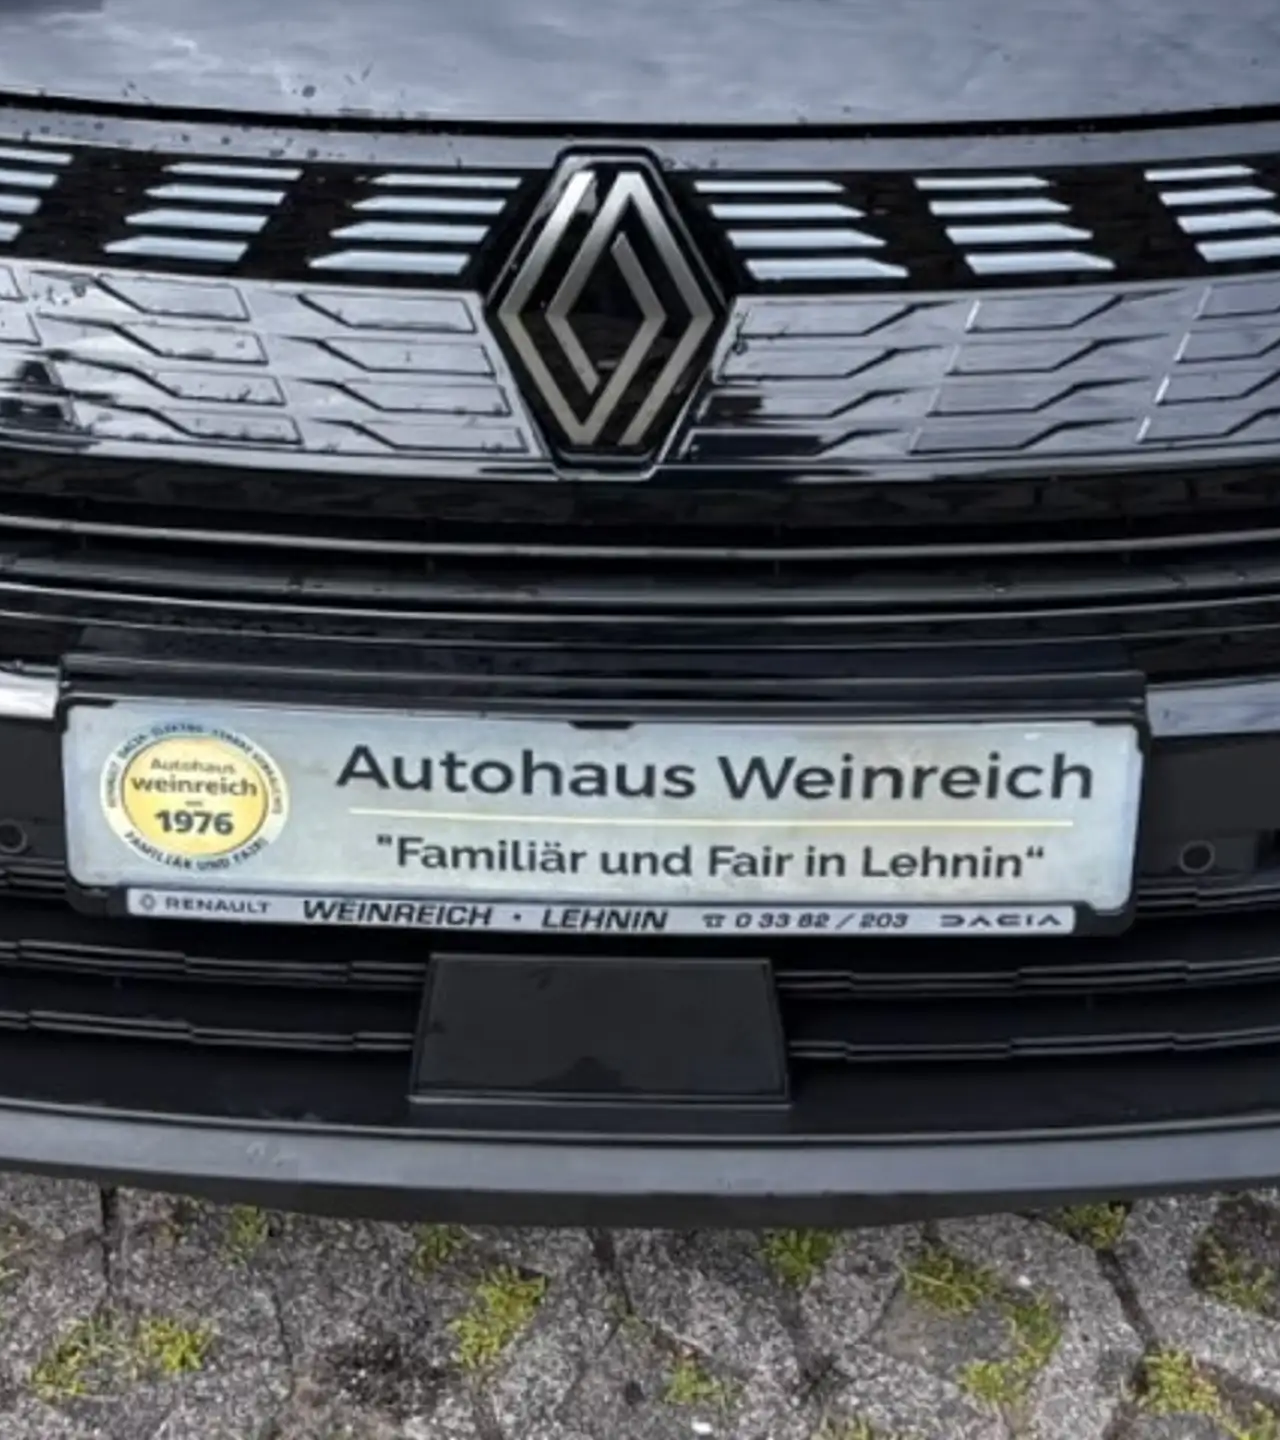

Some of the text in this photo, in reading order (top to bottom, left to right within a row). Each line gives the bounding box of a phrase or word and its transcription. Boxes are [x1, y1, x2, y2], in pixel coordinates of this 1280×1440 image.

[149, 757, 237, 775] Autohaus
[336, 744, 697, 800] Autohaus
[717, 750, 1094, 801] Weinreich
[130, 773, 259, 798] weinreich
[153, 809, 235, 837] 1976
[599, 845, 694, 878] und
[707, 844, 794, 879] Fair
[805, 843, 847, 879] in
[164, 895, 272, 916] RENAULT
[302, 898, 493, 928] WEINREICH
[540, 906, 669, 931] LEHNIN
[757, 911, 791, 929] 33
[857, 911, 910, 930] 203
